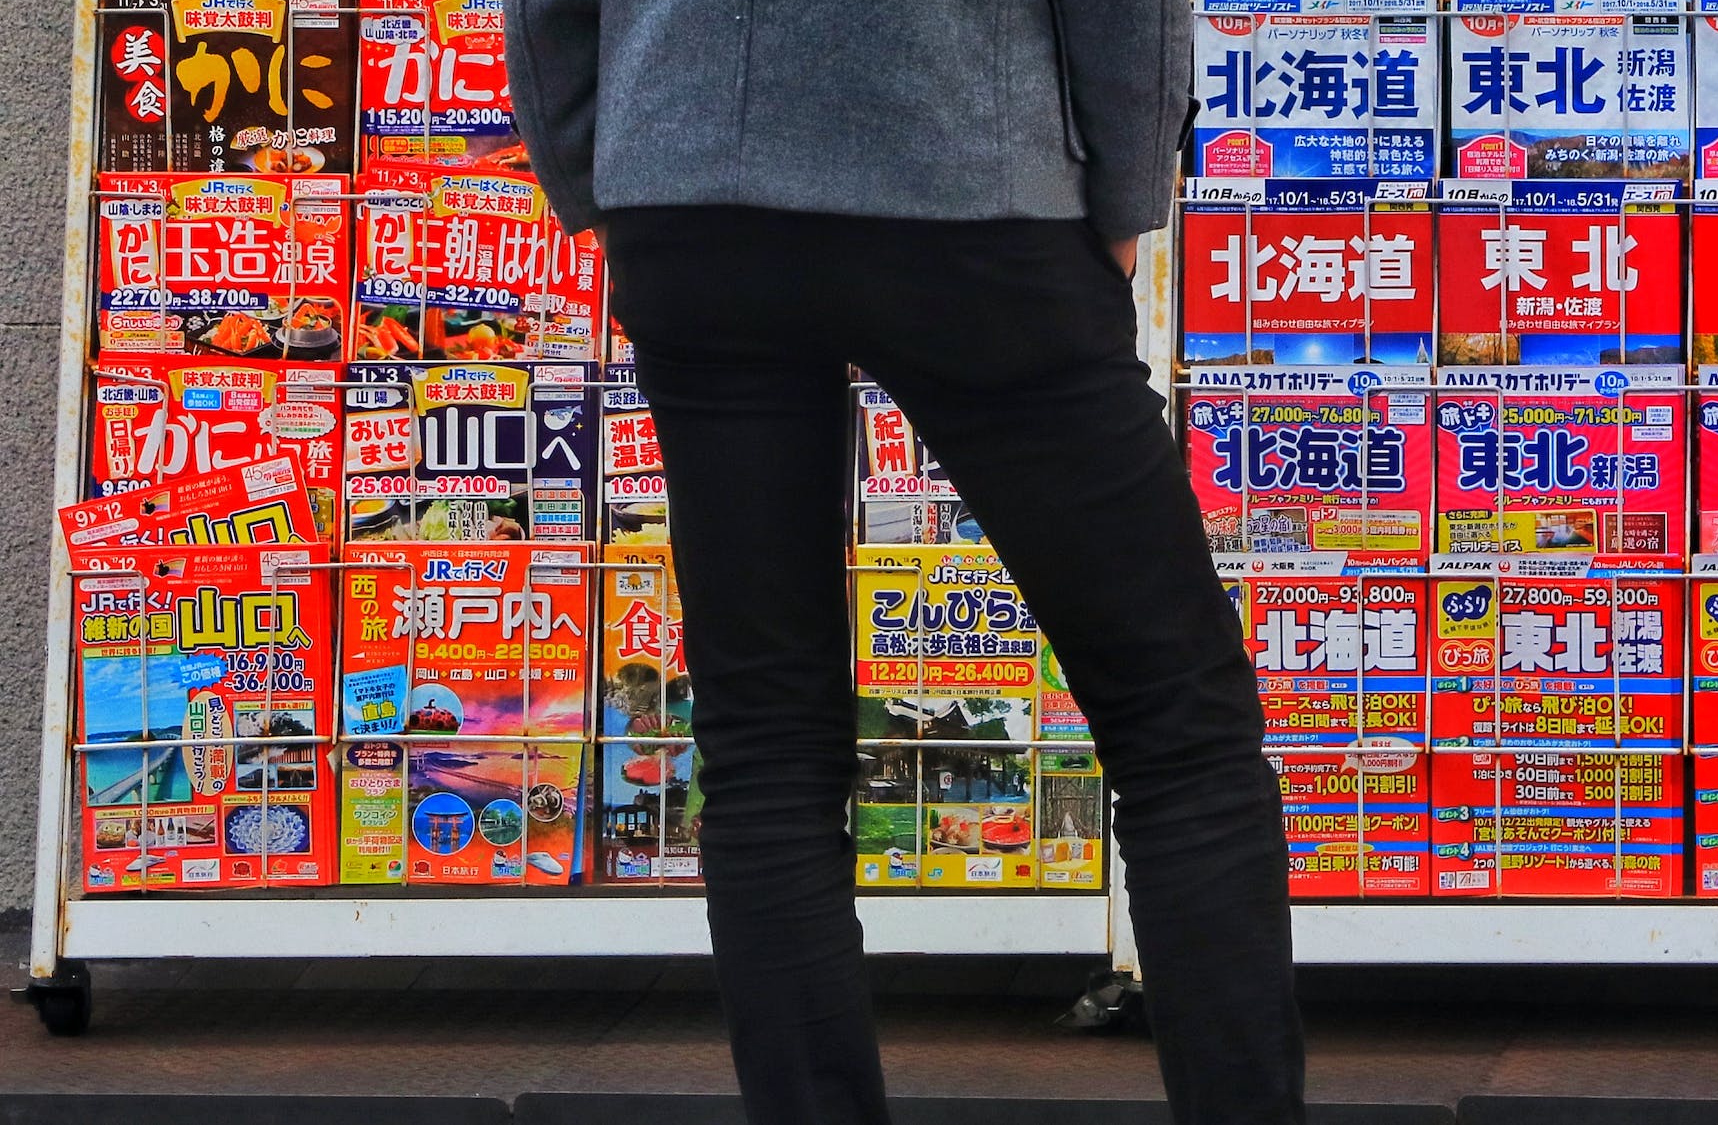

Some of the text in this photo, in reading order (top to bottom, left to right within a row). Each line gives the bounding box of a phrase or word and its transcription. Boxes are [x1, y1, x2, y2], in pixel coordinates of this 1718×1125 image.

[185, 10, 272, 29] 味覚太鼓判
[1206, 49, 1420, 118] 北海道
[1462, 47, 1607, 115] 東北
[185, 195, 273, 215] 味覚太鼓判
[201, 180, 254, 195] JRで行く
[1211, 234, 1416, 303] 北海道
[1481, 225, 1639, 293] 東北
[1516, 296, 1603, 317] 新潟・佐渡
[183, 372, 262, 387] 味覚太鼓判
[425, 407, 580, 472] 山口へ
[1214, 427, 1404, 491] 北海道
[1460, 429, 1587, 490] 東北
[177, 588, 312, 651] 山口へ
[1256, 610, 1417, 672] 北海道
